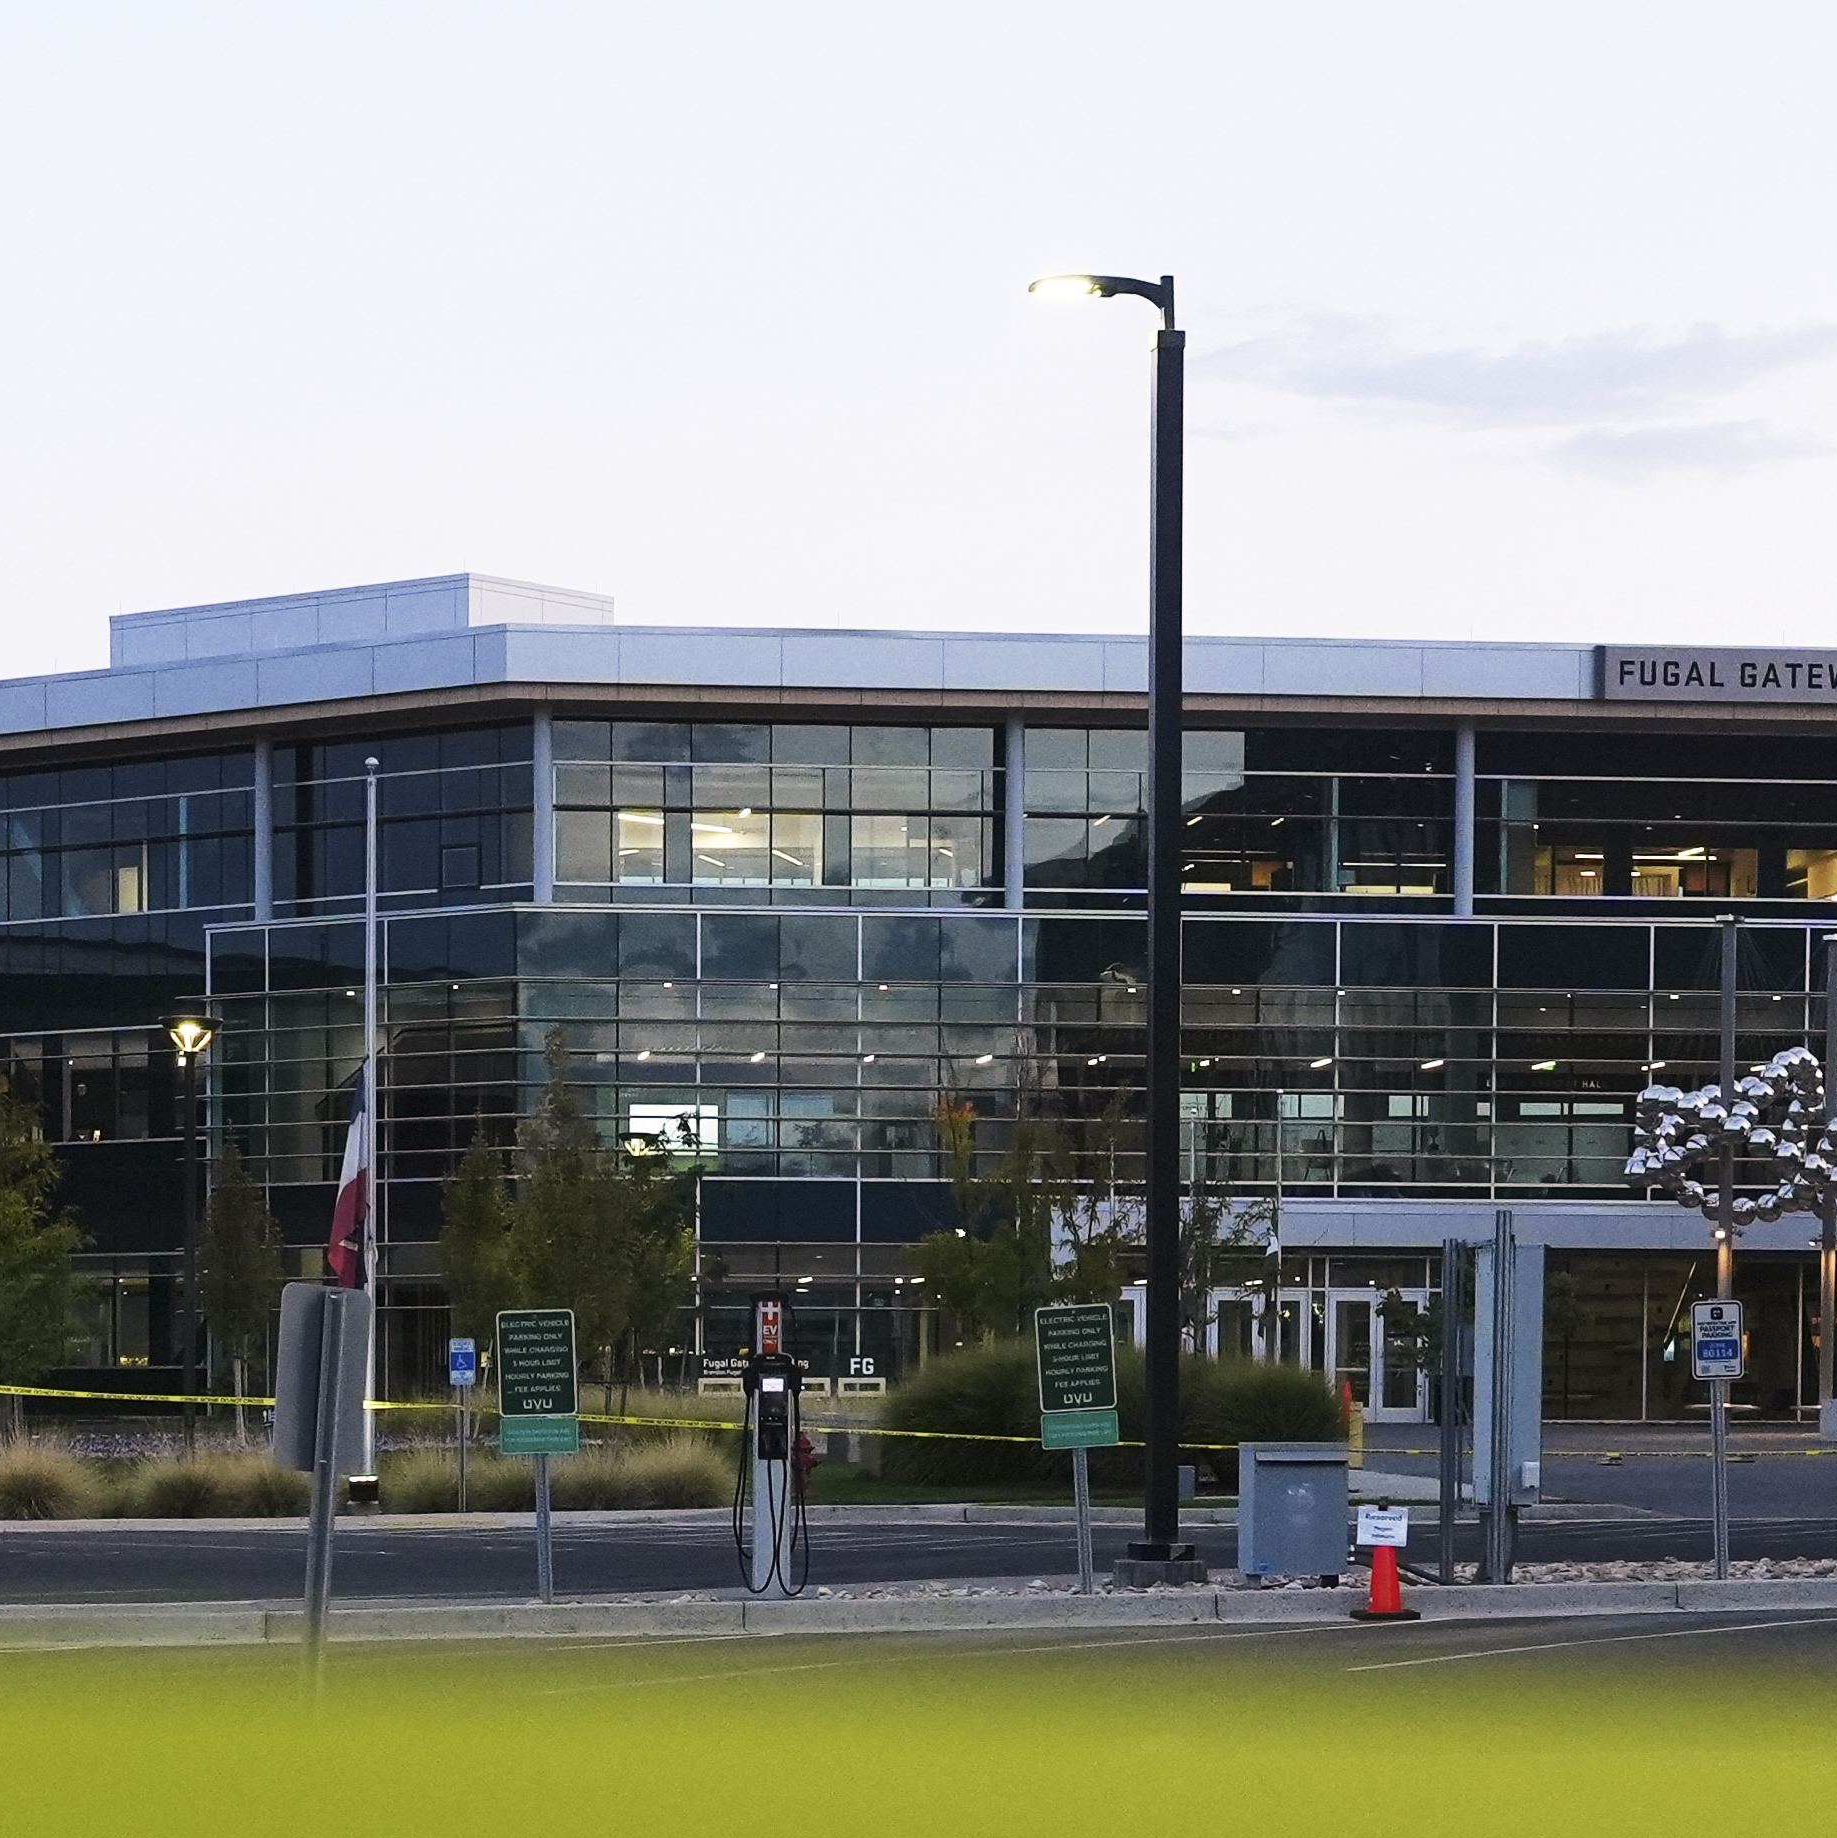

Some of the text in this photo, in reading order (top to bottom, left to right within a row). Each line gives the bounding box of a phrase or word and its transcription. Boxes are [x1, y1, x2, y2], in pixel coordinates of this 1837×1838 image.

[1619, 660, 1725, 688] FUGAL
[762, 1324, 778, 1336] EV
[703, 1358, 729, 1370] Fugal
[849, 1357, 875, 1375] FG
[523, 1399, 552, 1409] UVU
[1063, 1392, 1093, 1405] UVU
